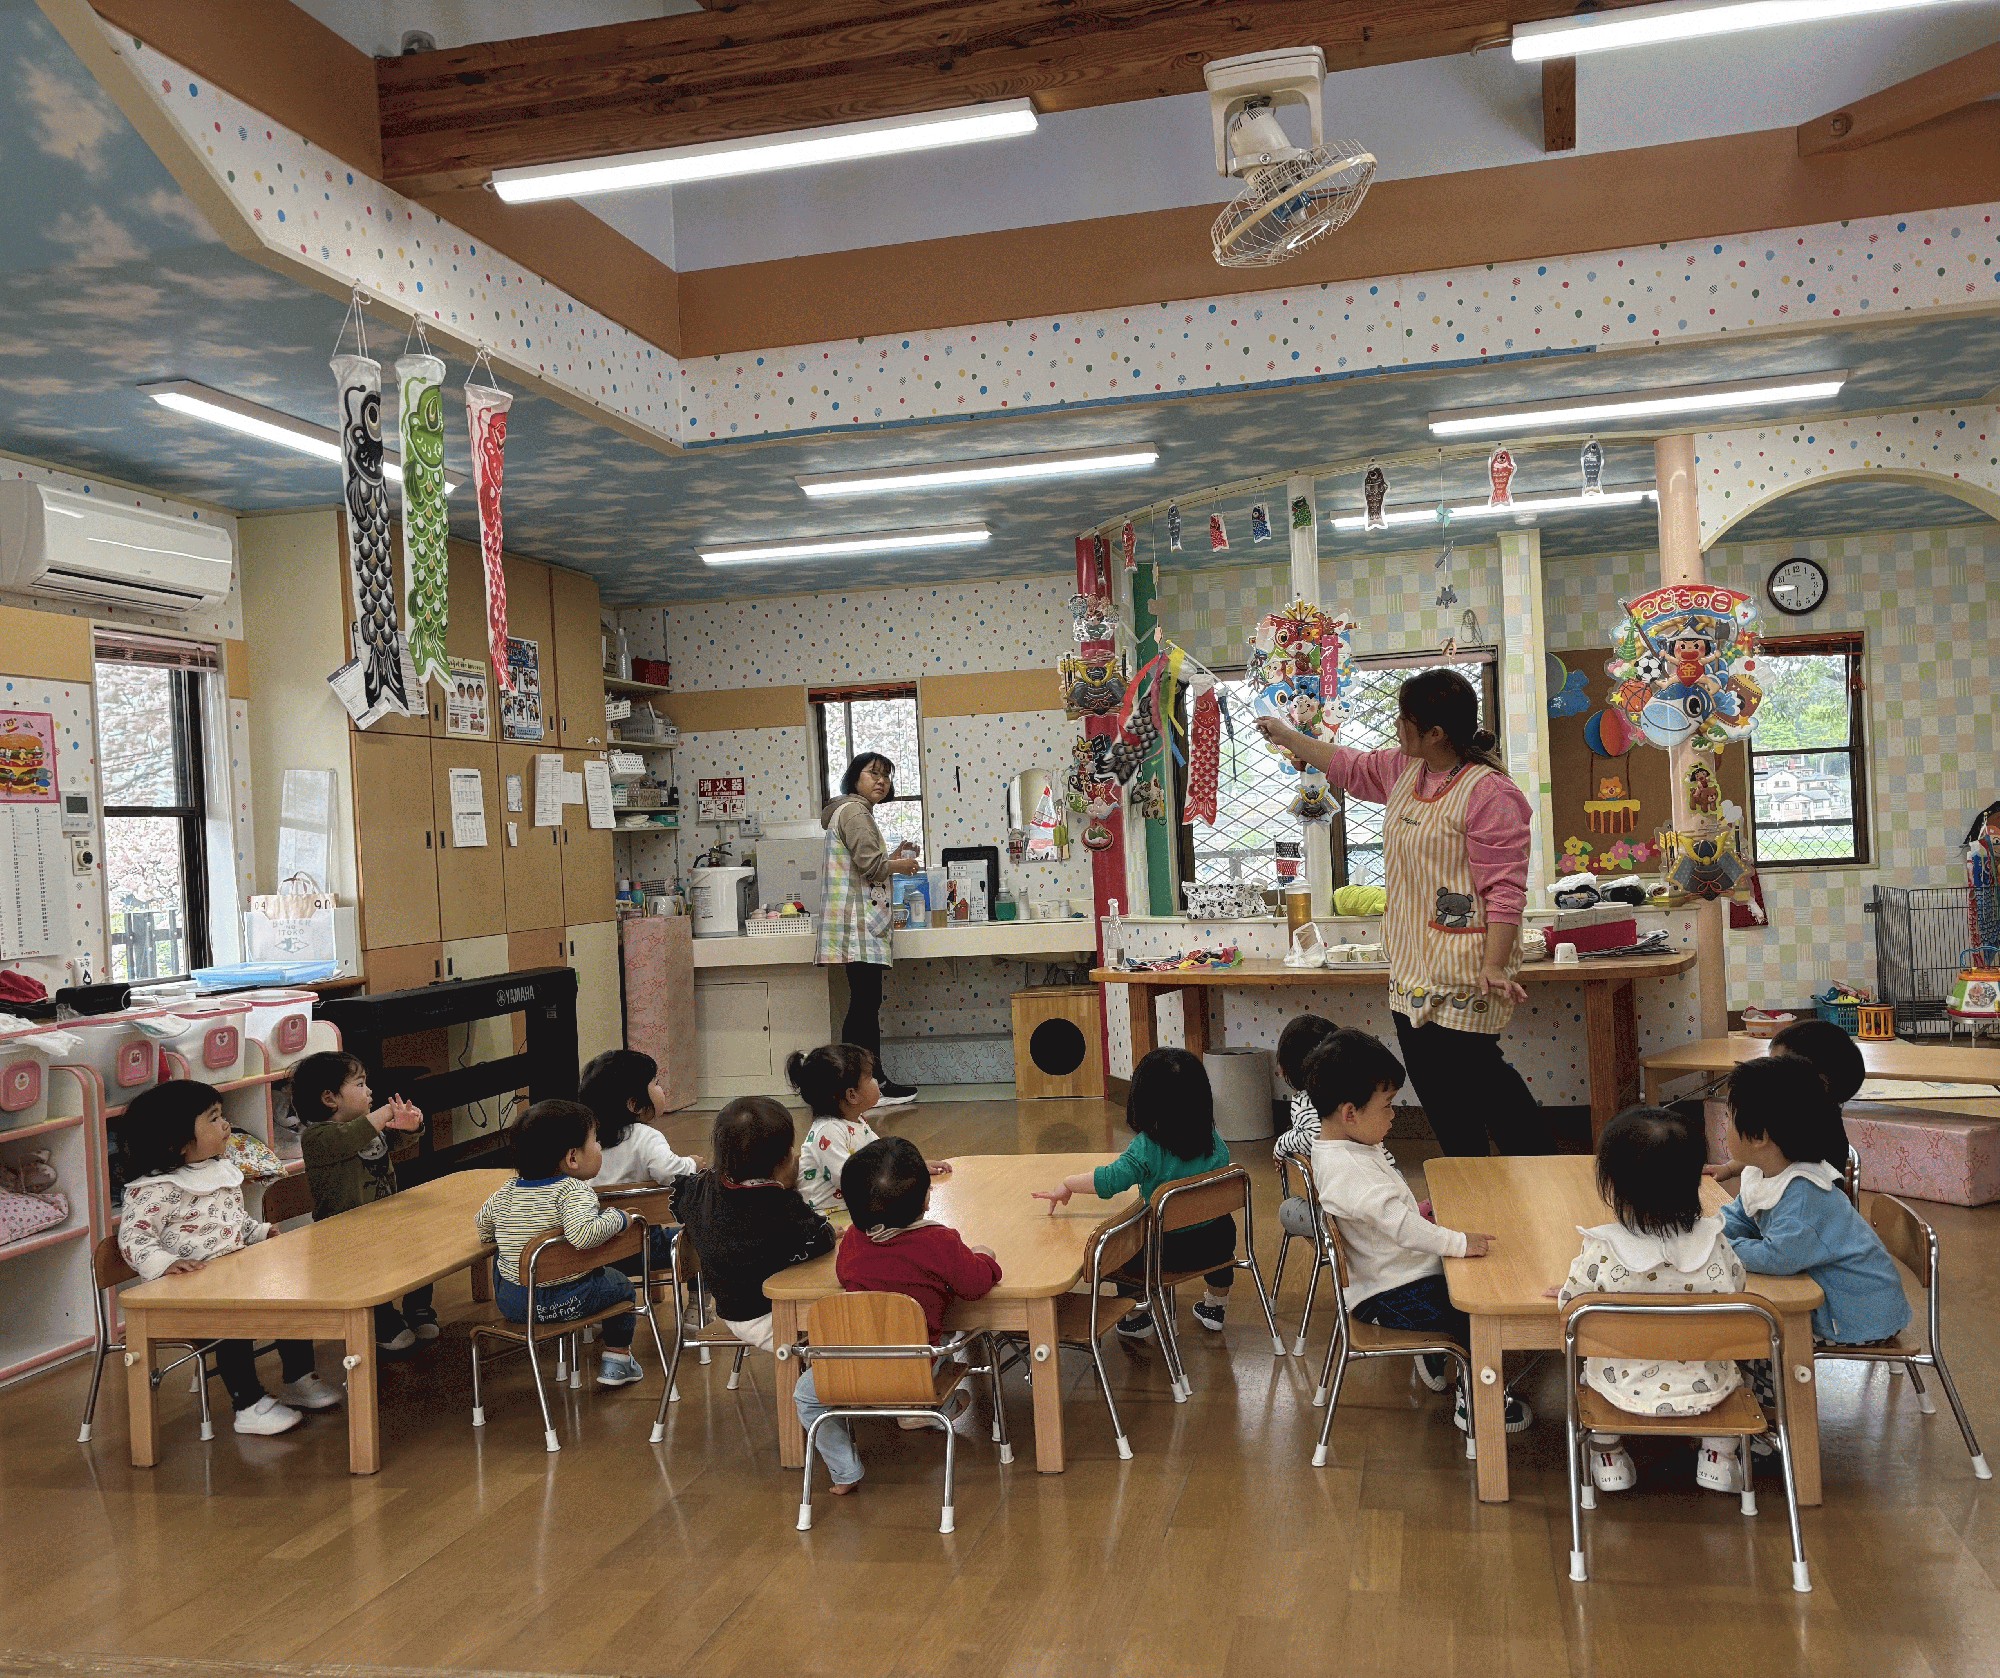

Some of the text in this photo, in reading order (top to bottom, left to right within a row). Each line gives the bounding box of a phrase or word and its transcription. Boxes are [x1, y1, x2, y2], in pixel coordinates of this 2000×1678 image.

[1793, 565, 1800, 574] 12
[1810, 572, 1816, 580] 2
[1638, 589, 1733, 620] こどもの日
[1681, 662, 1697, 678] 金
[700, 778, 743, 792] 消火器
[505, 985, 535, 1005] YAMAHA
